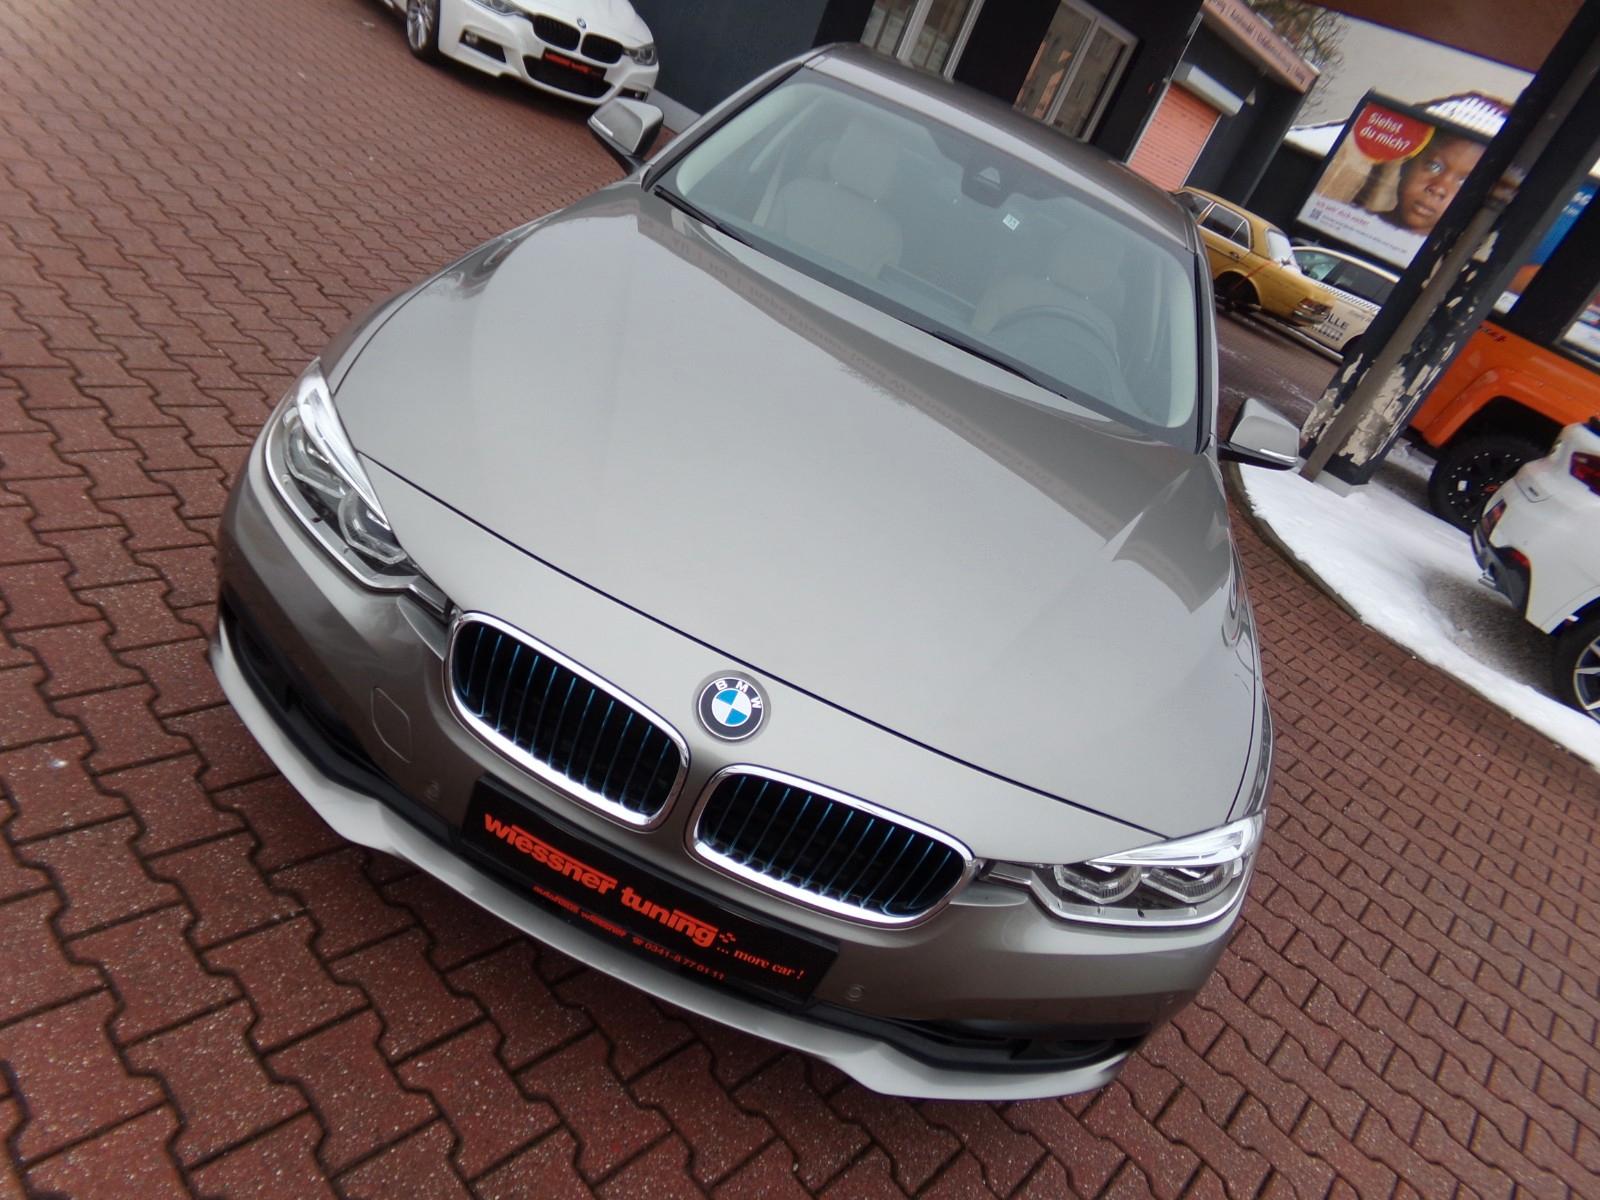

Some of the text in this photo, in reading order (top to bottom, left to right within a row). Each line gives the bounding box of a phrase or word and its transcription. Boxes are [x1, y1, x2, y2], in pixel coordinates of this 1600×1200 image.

[1369, 111, 1403, 135] Siehst
[1360, 126, 1410, 152] du mich?
[714, 679, 762, 709] BMW
[483, 813, 719, 948] wiessner tuning
[734, 950, 770, 968] more
